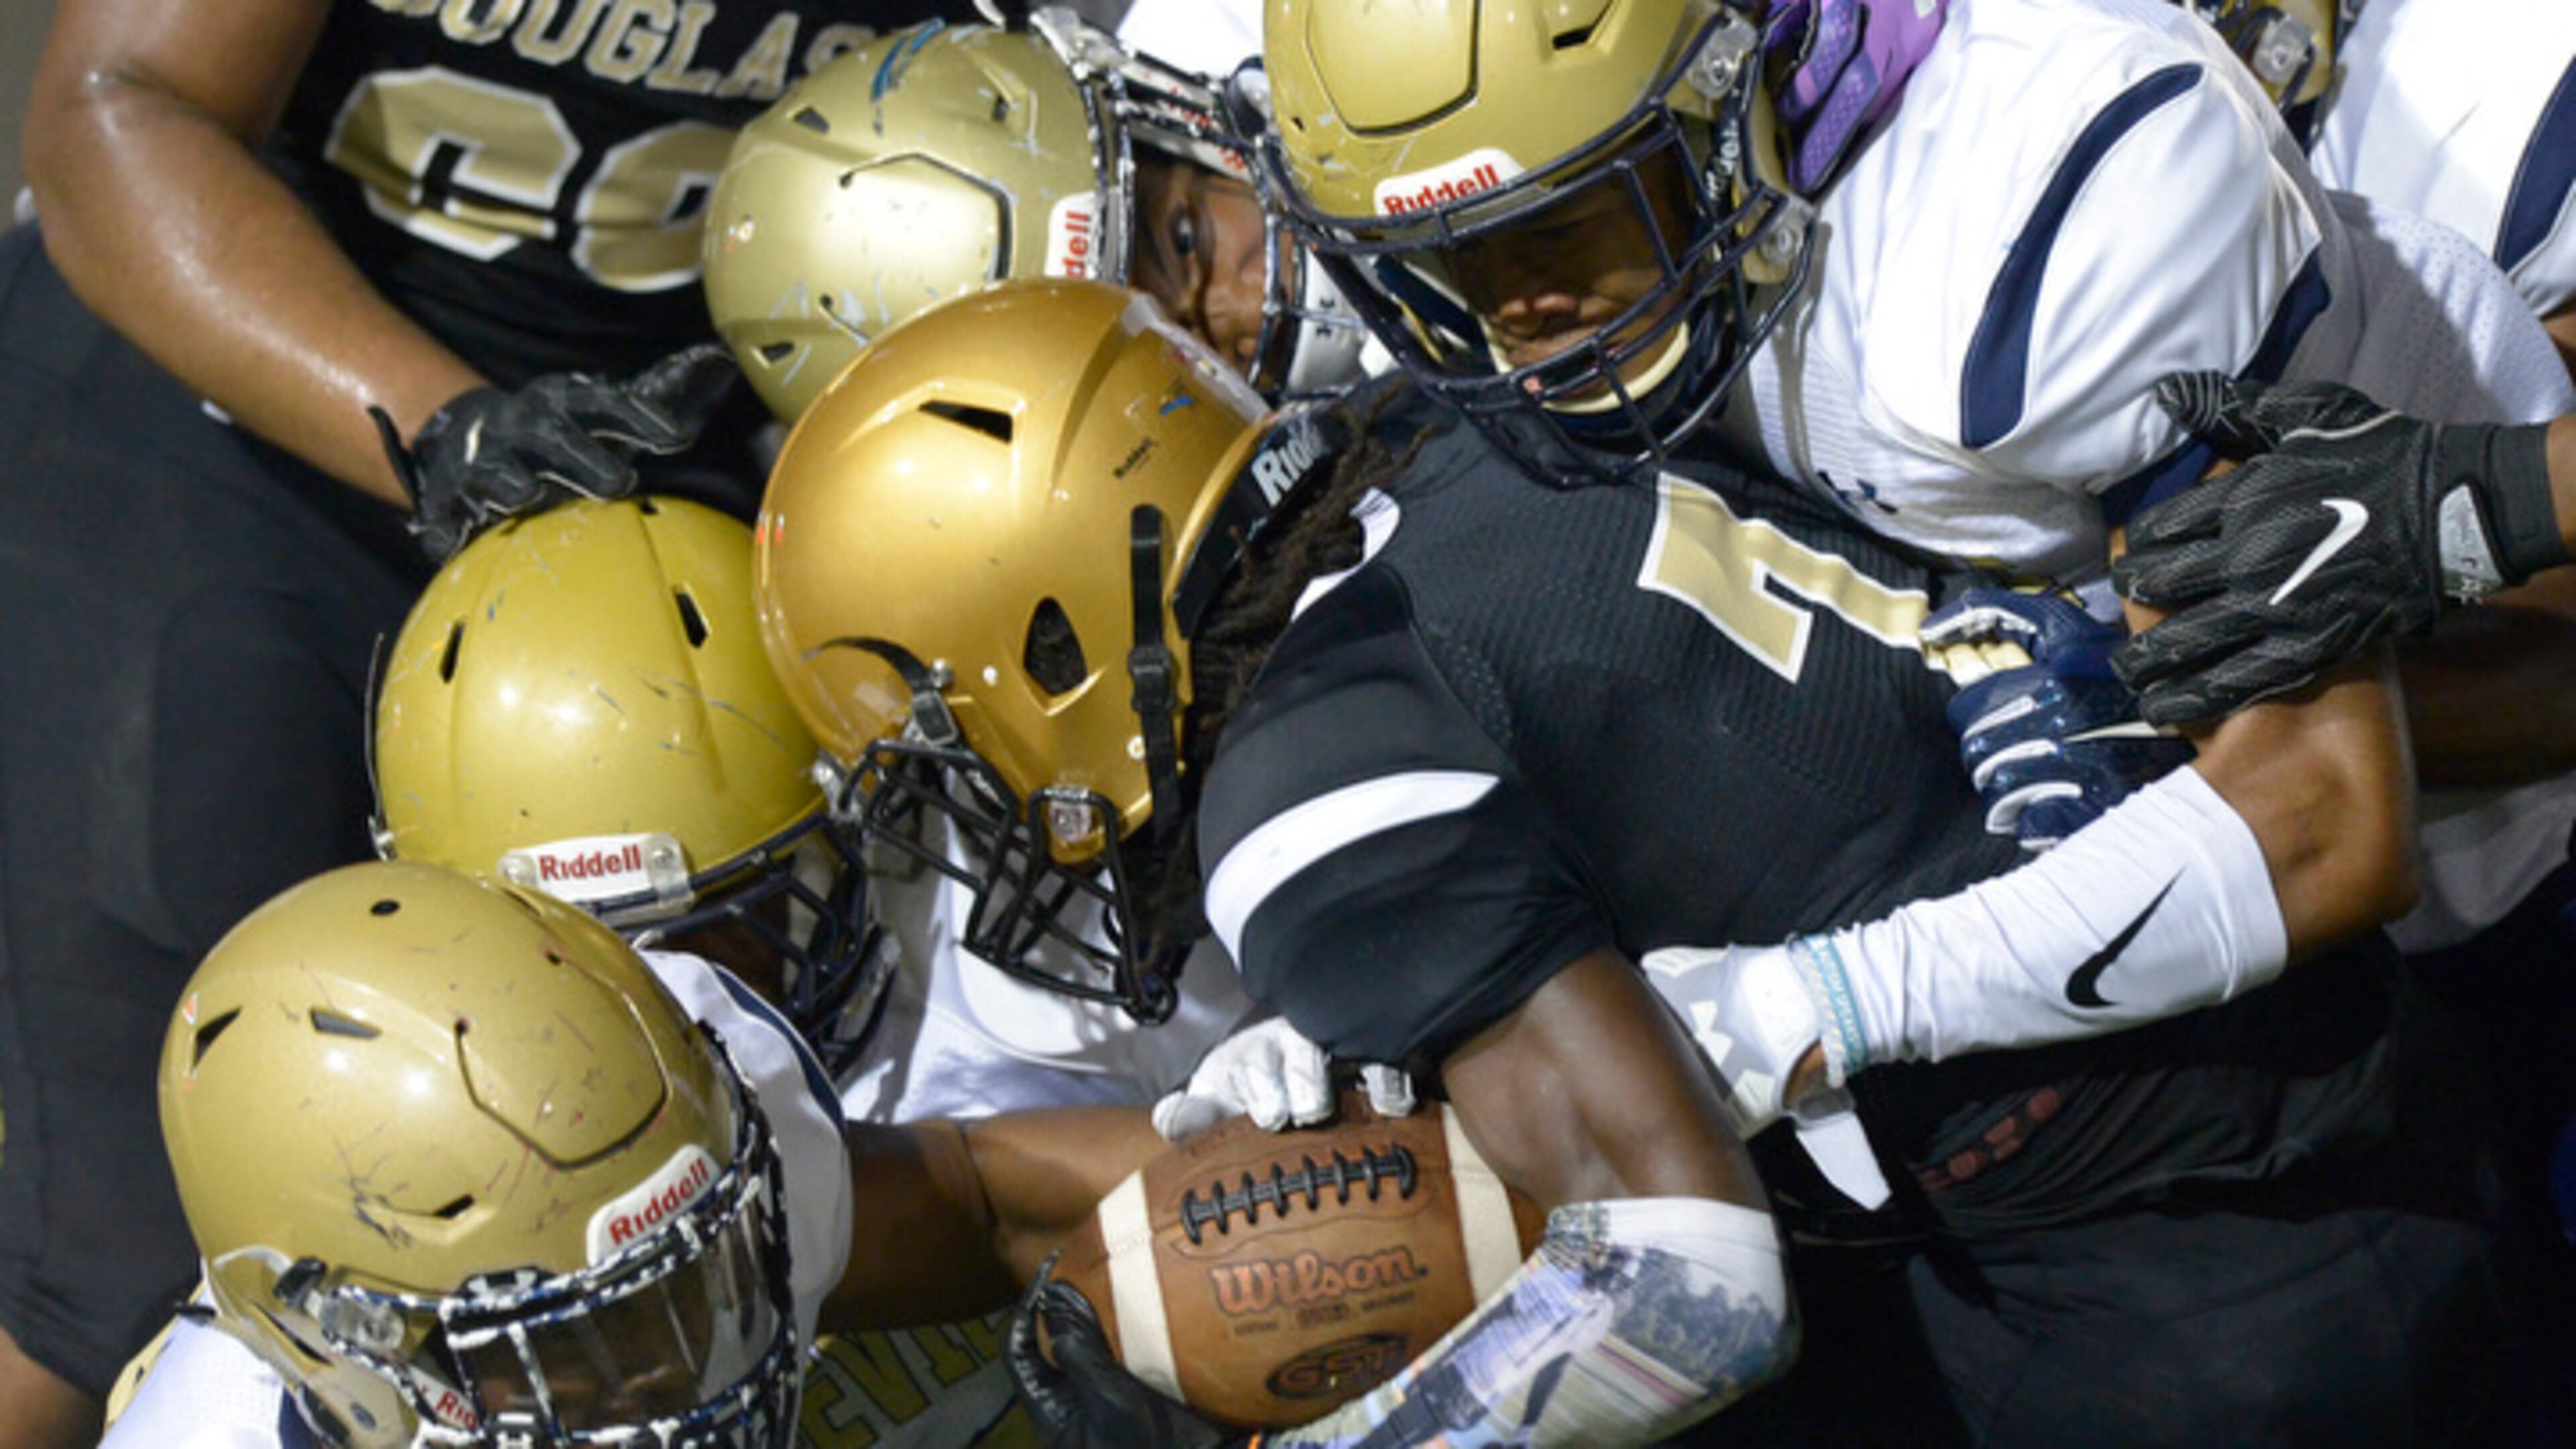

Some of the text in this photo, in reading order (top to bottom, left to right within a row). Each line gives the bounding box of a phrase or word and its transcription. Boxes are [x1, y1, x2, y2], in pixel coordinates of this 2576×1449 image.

[368, 0, 876, 101] OUGLA
[1383, 164, 1500, 215] Riddell
[539, 844, 642, 880] Riddell
[609, 1158, 710, 1245] Riddell
[1210, 1244, 1415, 1317] Wilson
